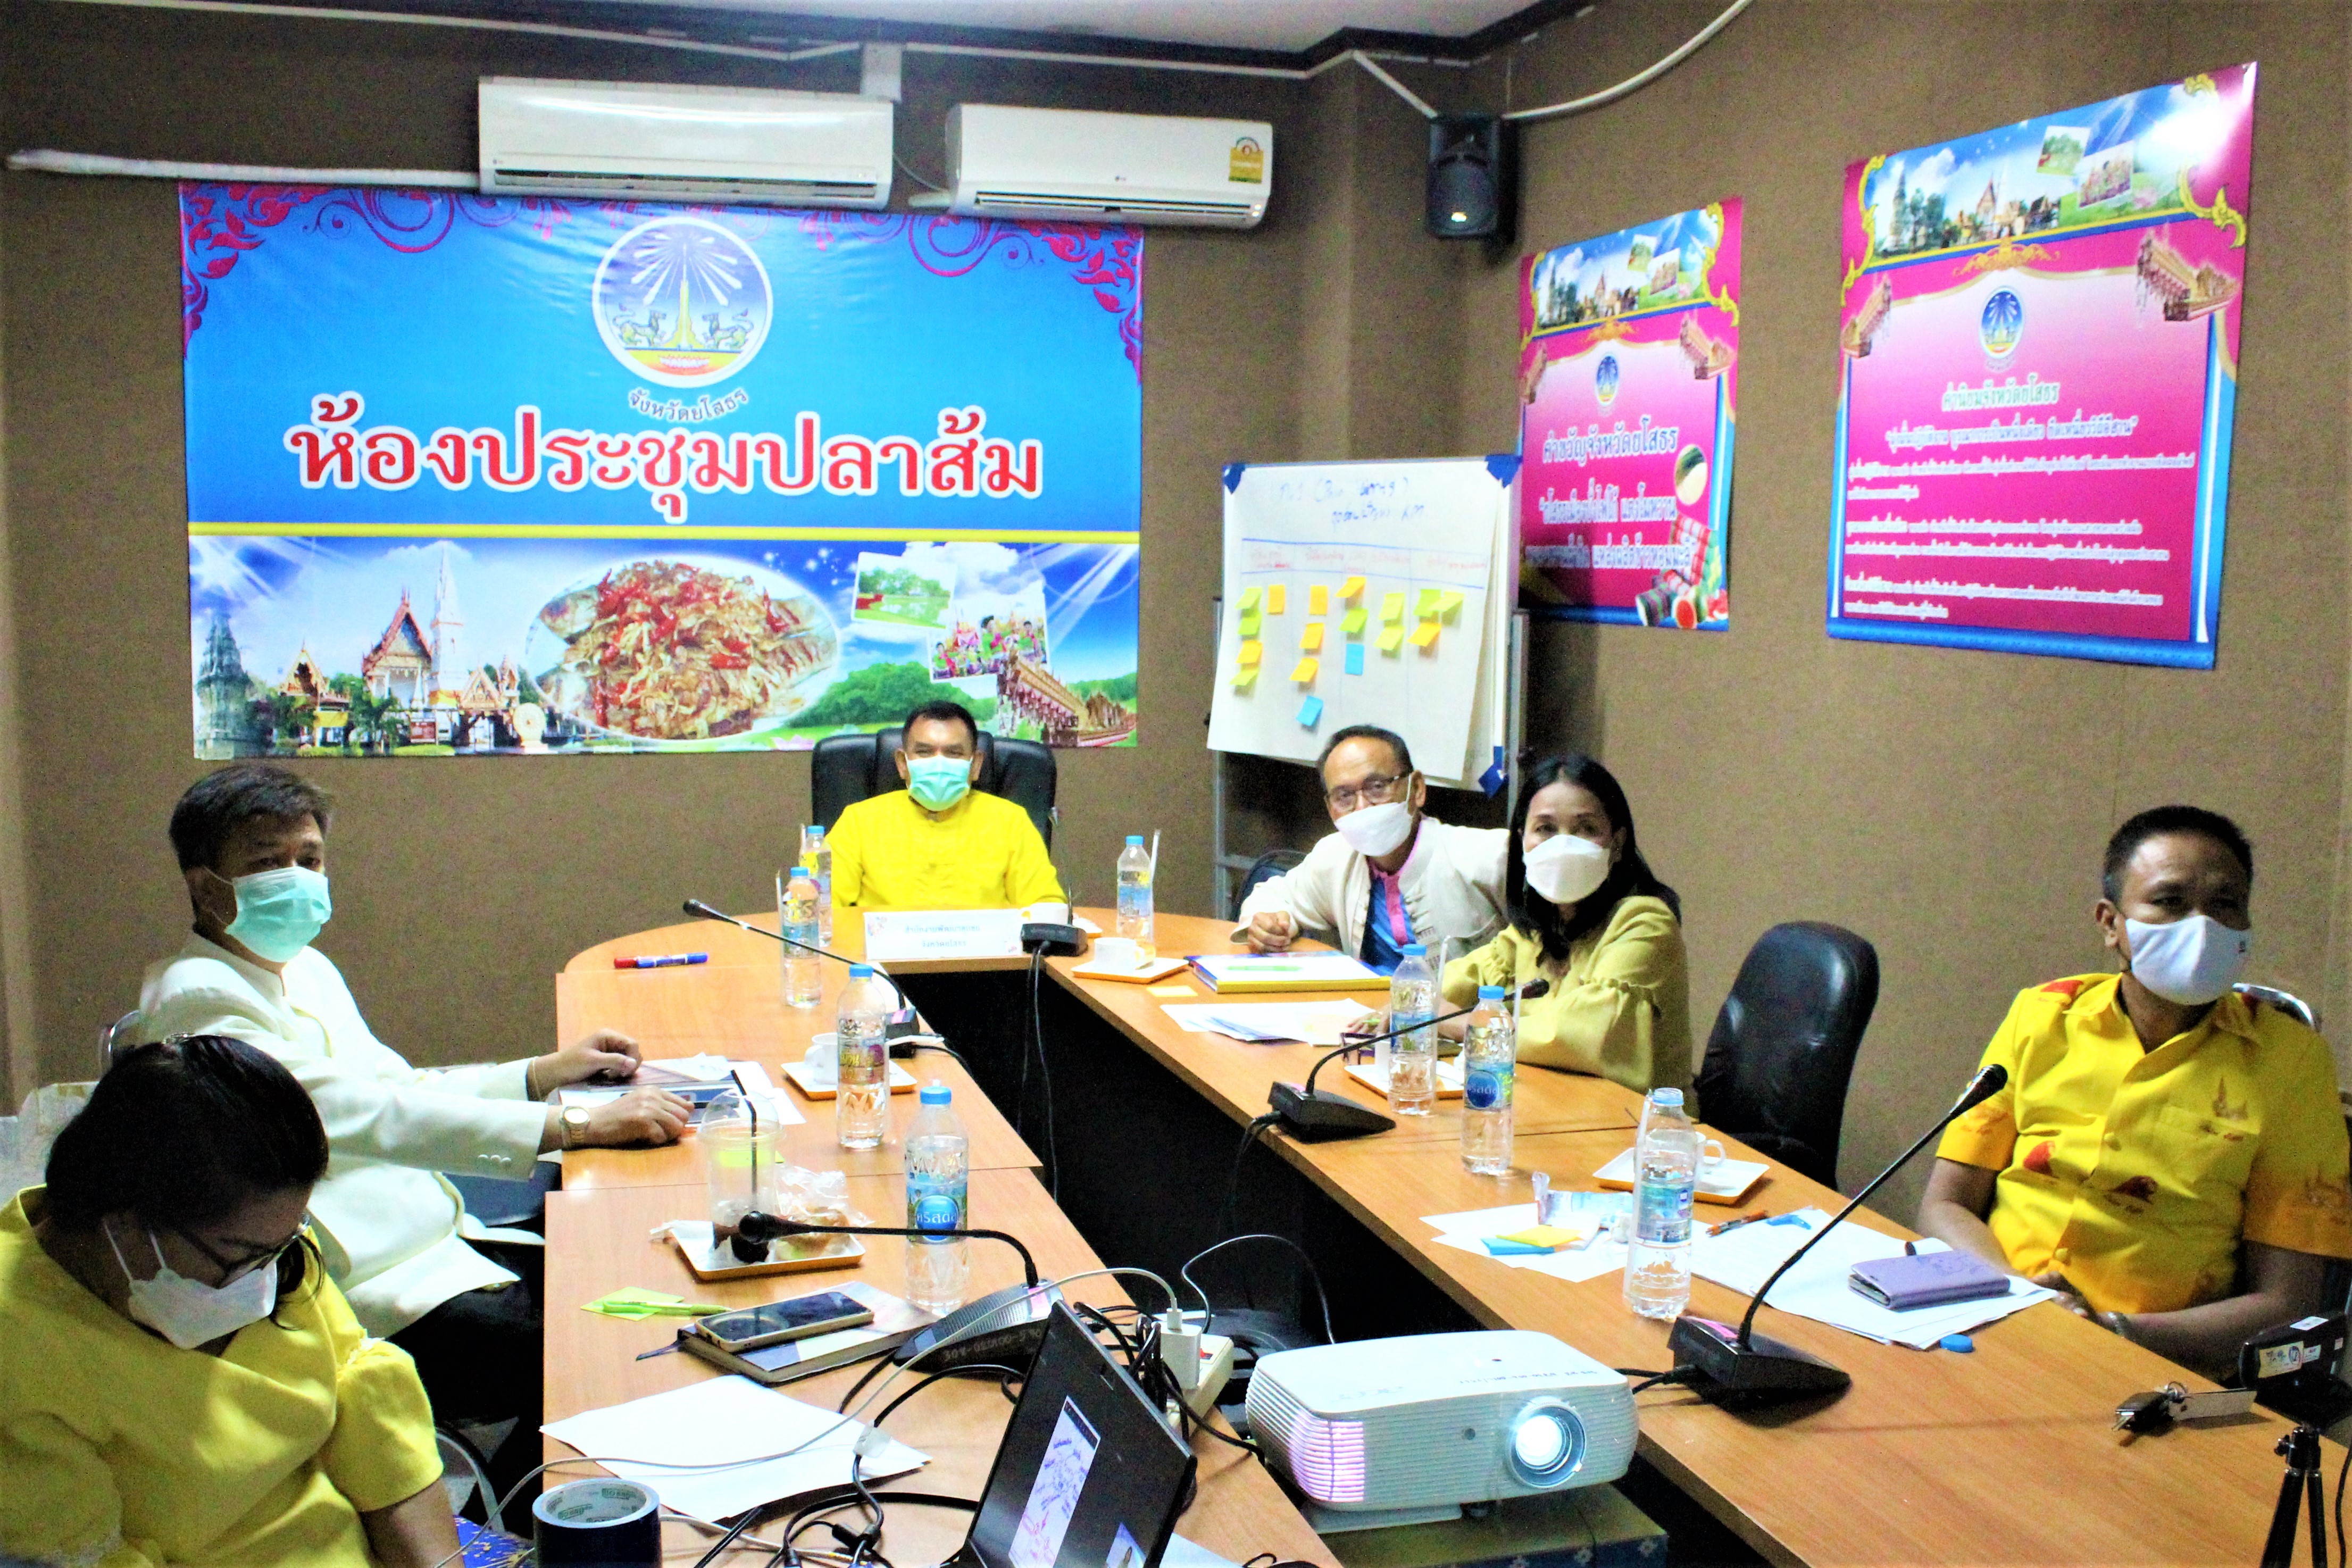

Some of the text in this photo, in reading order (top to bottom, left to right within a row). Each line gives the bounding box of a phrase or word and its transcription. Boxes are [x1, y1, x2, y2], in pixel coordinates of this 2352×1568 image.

[629, 388, 748, 421] จังหวัดยโสธร
[290, 398, 1039, 518] ห้องประชุมปลาส้ม
[1544, 416, 1677, 464] คำขวัญจังหวัดยโสธร
